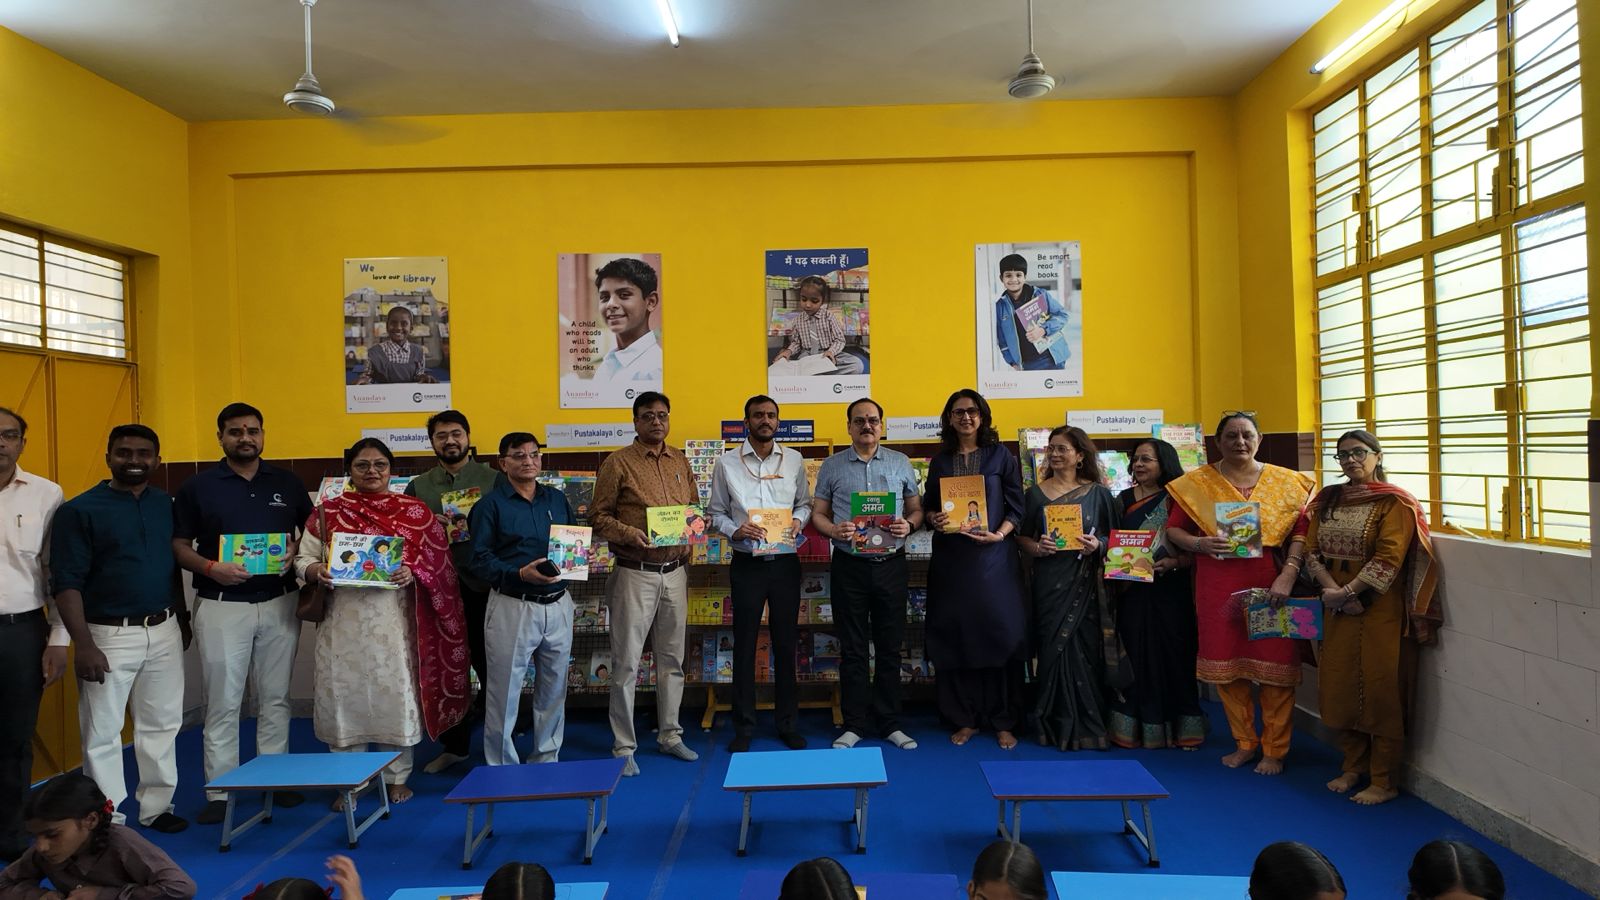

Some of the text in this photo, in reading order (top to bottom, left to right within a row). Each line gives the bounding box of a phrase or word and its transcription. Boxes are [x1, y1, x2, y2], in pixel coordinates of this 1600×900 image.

[785, 255, 793, 265] मैं
[795, 257, 808, 267] पढ़
[810, 254, 836, 265] सकती
[360, 264, 375, 272] We
[403, 274, 436, 285] library
[1096, 416, 1136, 424] Pustakalaya
[913, 422, 942, 430] Pustakal
[574, 429, 613, 438] Pustakalaya
[861, 504, 885, 512] अमन
[1120, 538, 1145, 546] अमन
